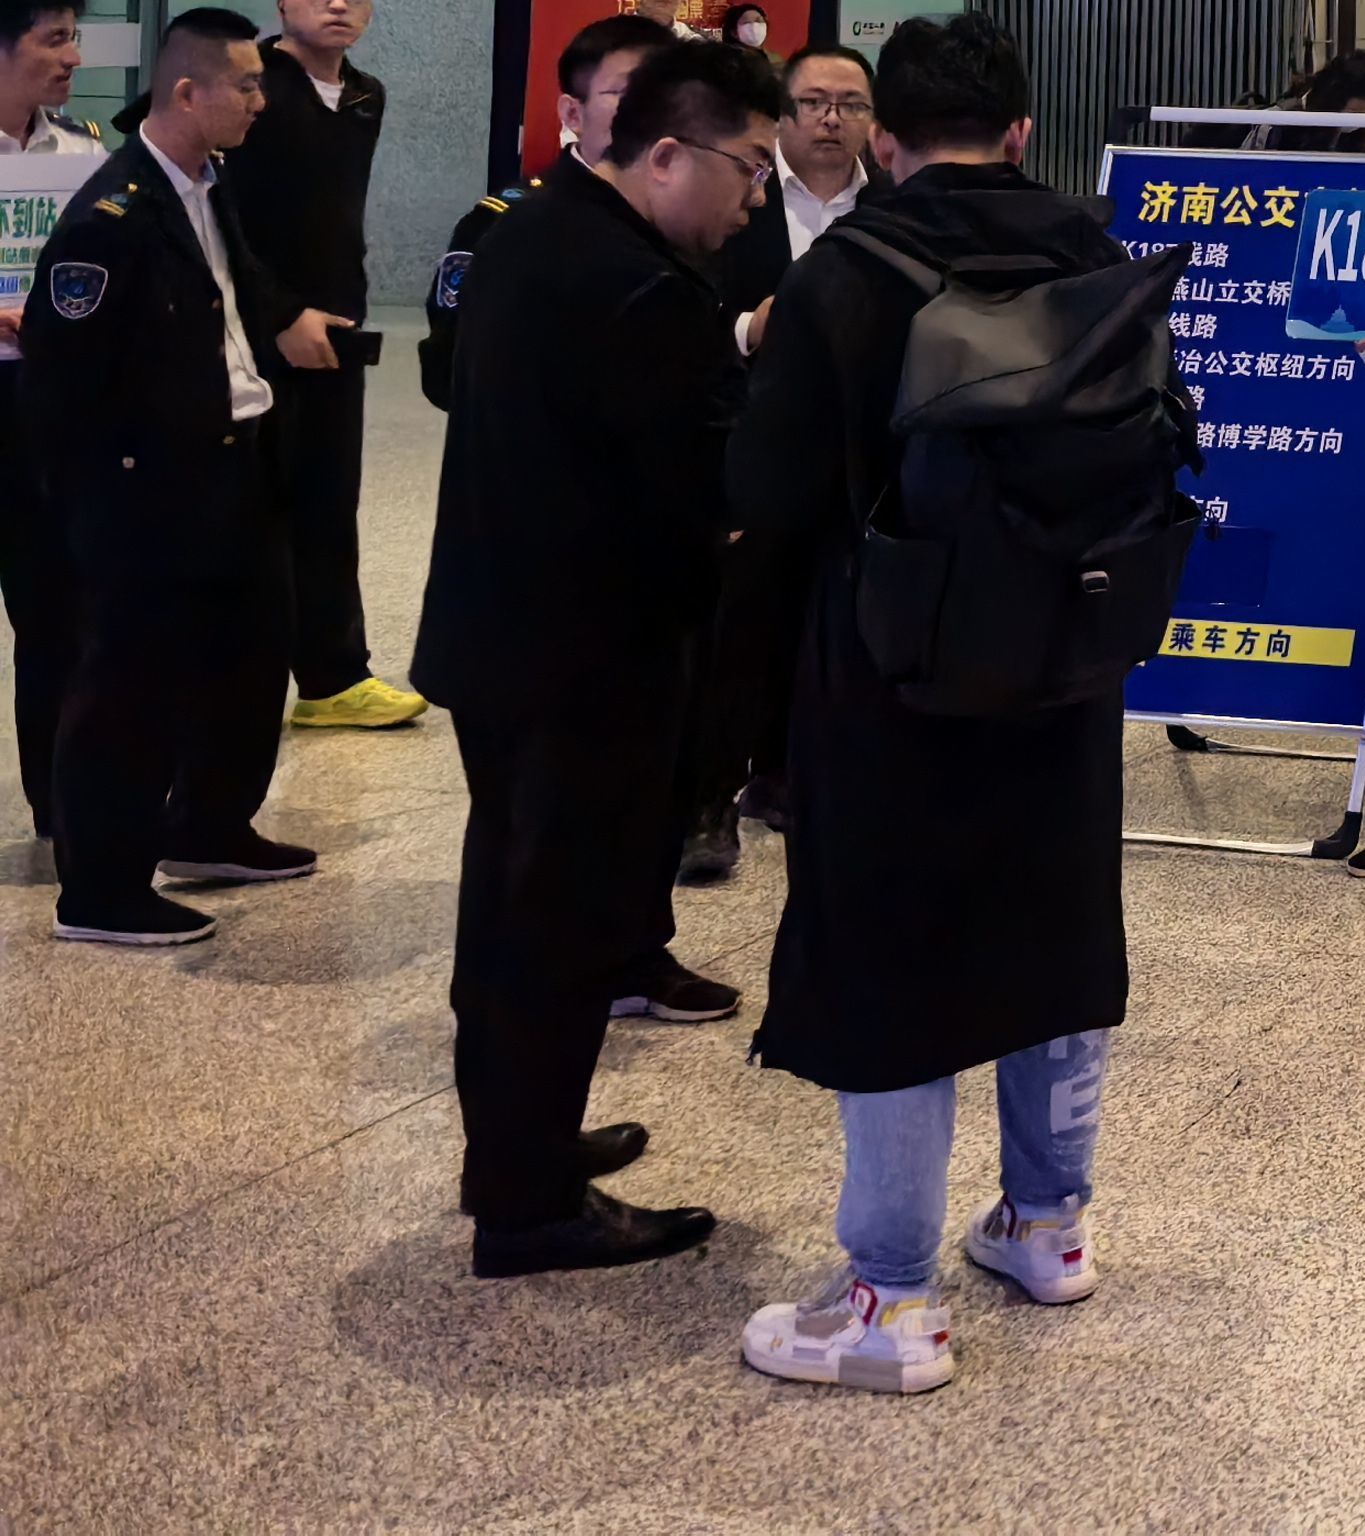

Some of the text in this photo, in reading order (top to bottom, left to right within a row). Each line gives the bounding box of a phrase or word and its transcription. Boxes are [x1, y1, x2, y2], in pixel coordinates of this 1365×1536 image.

[1138, 180, 1300, 229] 济南公交
[1173, 348, 1355, 381] 冶公交枢纽方向
[1168, 623, 1292, 658] 乘车方向
